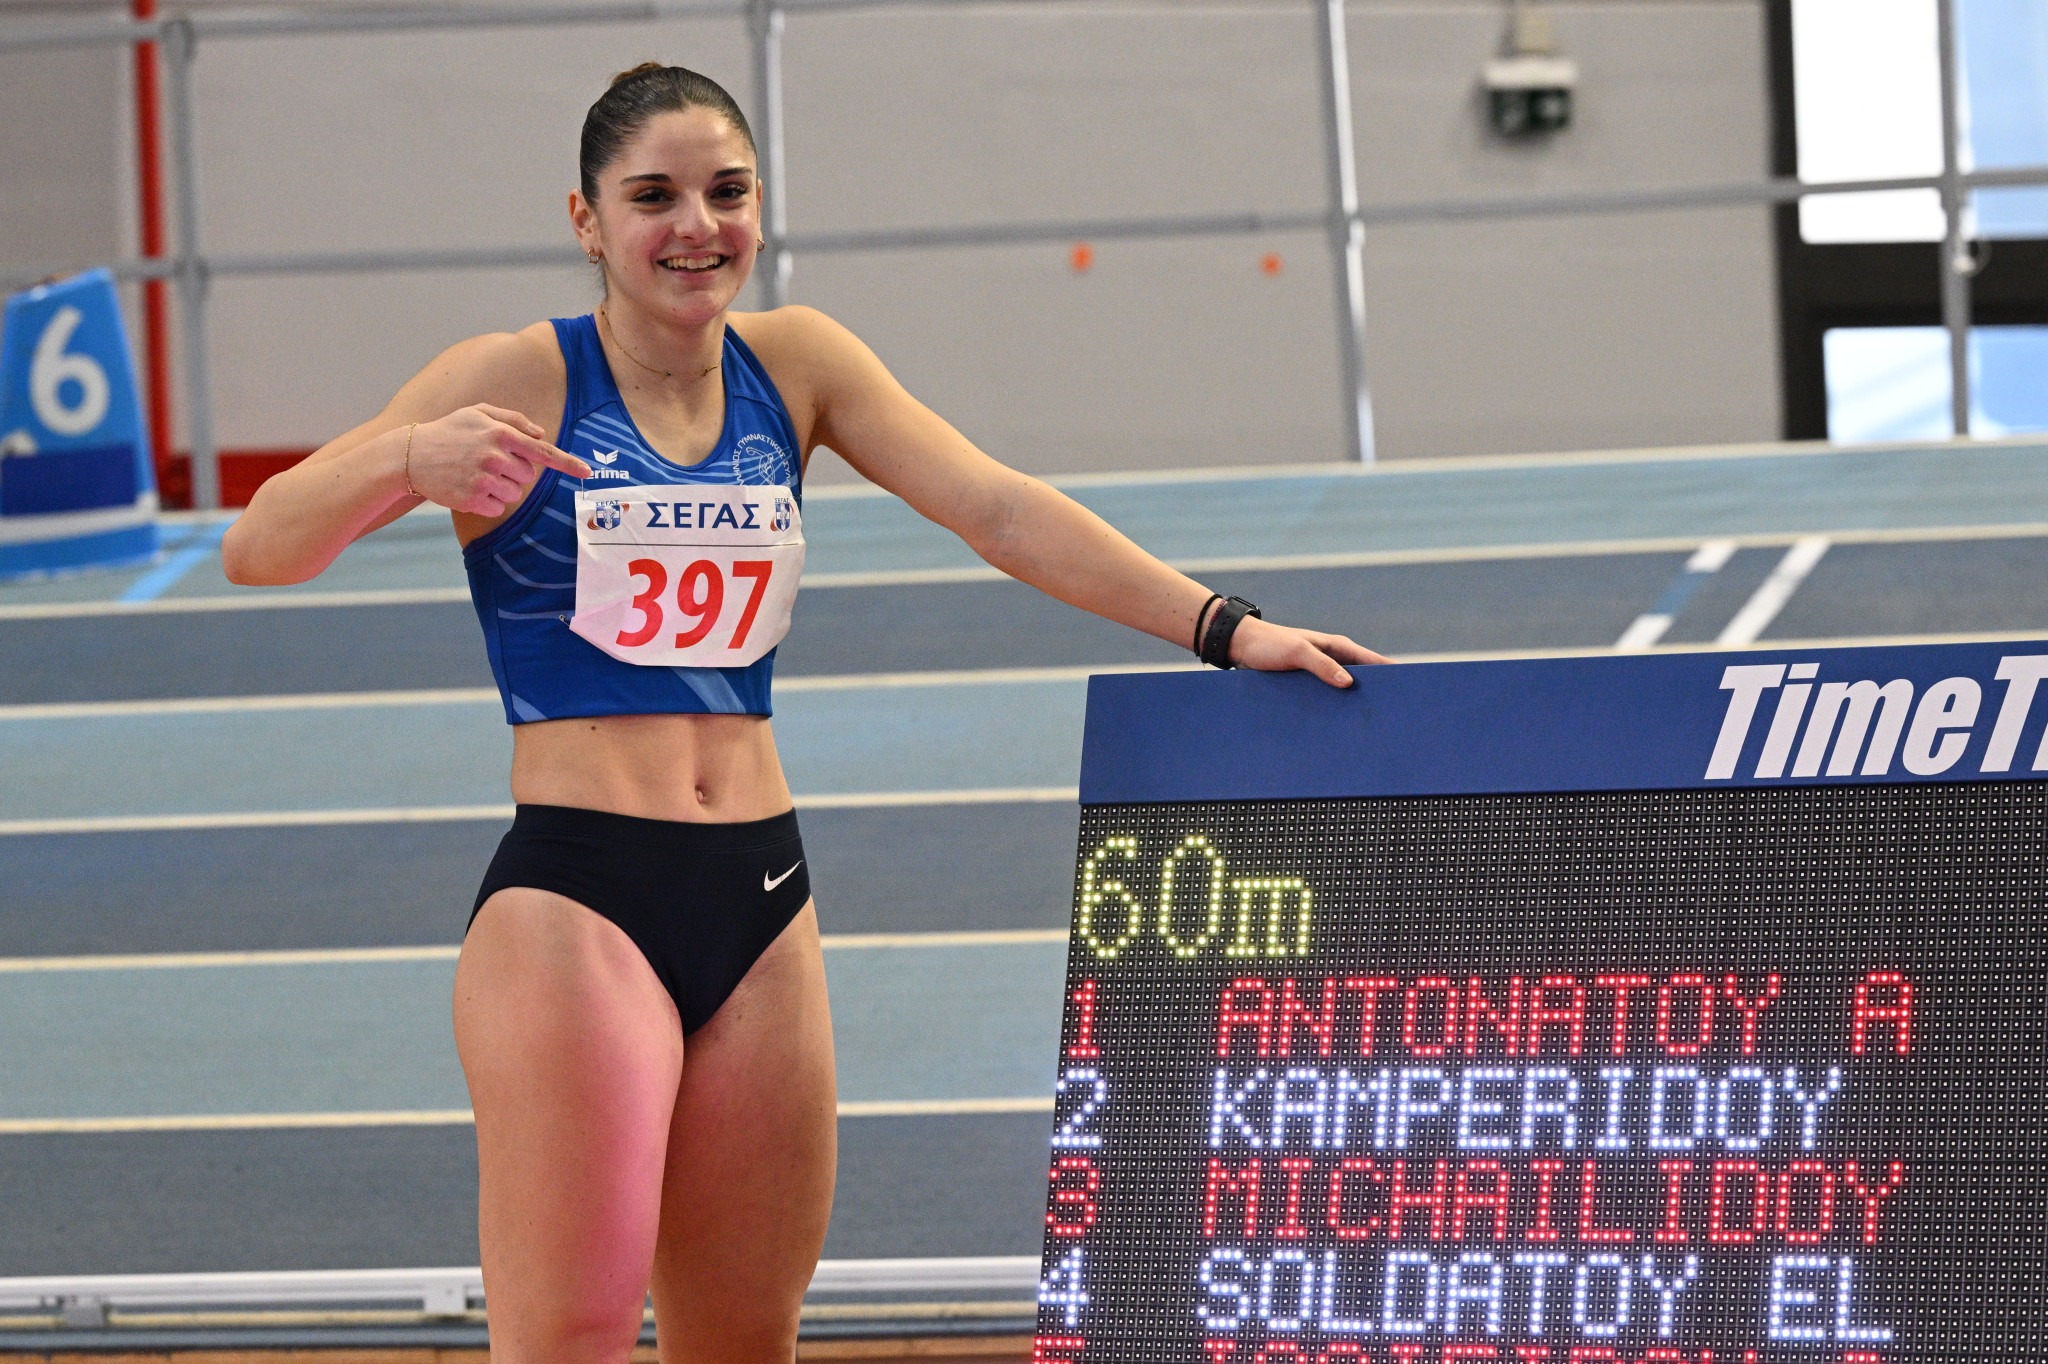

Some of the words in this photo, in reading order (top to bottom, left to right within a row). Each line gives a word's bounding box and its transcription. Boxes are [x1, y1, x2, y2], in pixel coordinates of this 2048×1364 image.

[30, 305, 110, 437] 6
[647, 502, 761, 530] ΣΕΓΑΣ
[615, 558, 773, 649] 397
[1078, 834, 1313, 959] 60m
[1067, 979, 1101, 1059] 1
[1217, 972, 1782, 1058] ANTONATOY
[1851, 971, 1913, 1055] A
[1051, 1067, 1107, 1149] 2
[1208, 1065, 1843, 1152] KAMPERIDOY
[1043, 1156, 1101, 1237] 3
[1202, 1157, 1904, 1245] MICHAILIDOY
[1036, 1246, 1091, 1329] 4
[1196, 1247, 1699, 1339] SOLDATOY
[1767, 1255, 1894, 1343] EL
